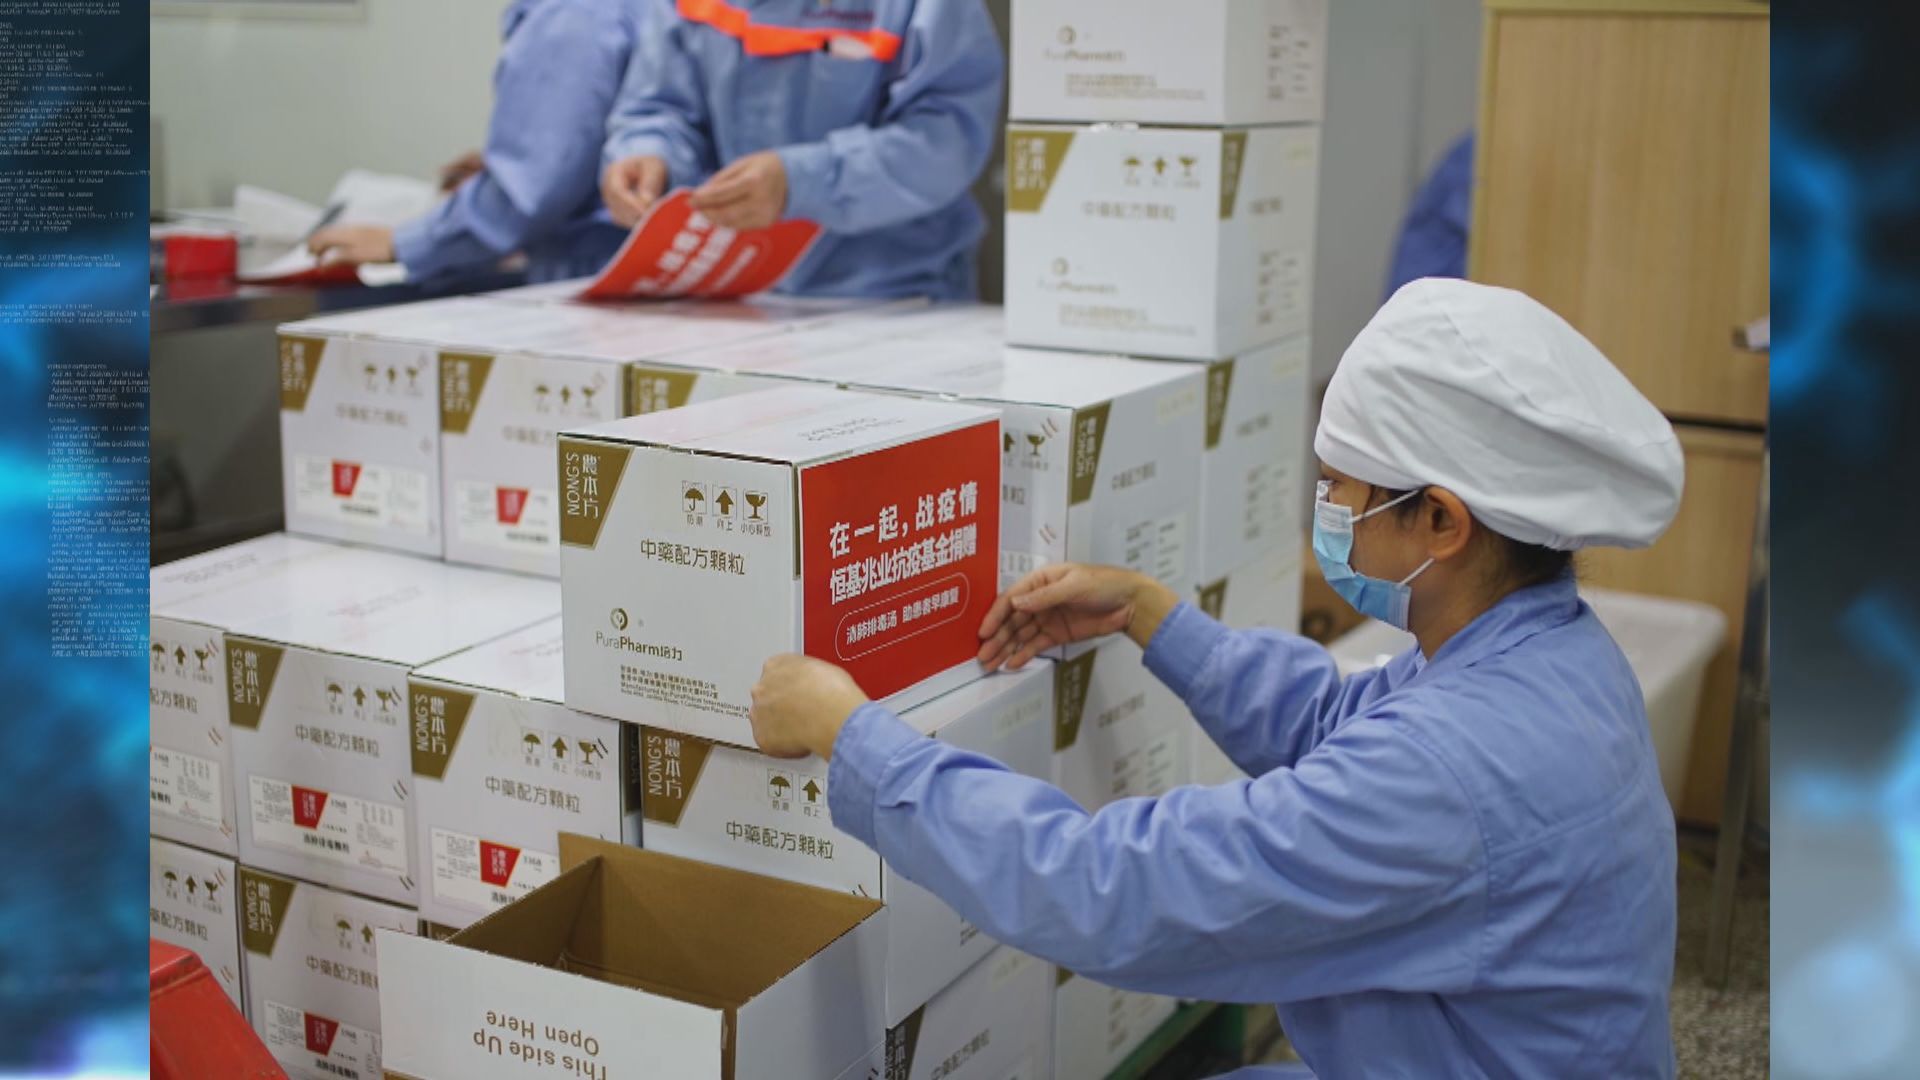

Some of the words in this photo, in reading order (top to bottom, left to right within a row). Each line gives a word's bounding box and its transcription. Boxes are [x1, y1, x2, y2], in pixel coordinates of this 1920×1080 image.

[566, 452, 580, 516] NONG'S
[582, 453, 599, 519] 農本方
[829, 480, 978, 559] 在一起，战疫情
[640, 538, 746, 576] 中藥配方顆粒
[829, 522, 977, 605] 恒基兆业抗疫基金捐赠
[647, 736, 662, 796] NONG'S
[726, 820, 834, 860] 中藥配方顆粒
[473, 1028, 502, 1055] Up
[486, 1010, 535, 1041] Here
[545, 1025, 600, 1057] Open
[509, 1041, 556, 1066] side
